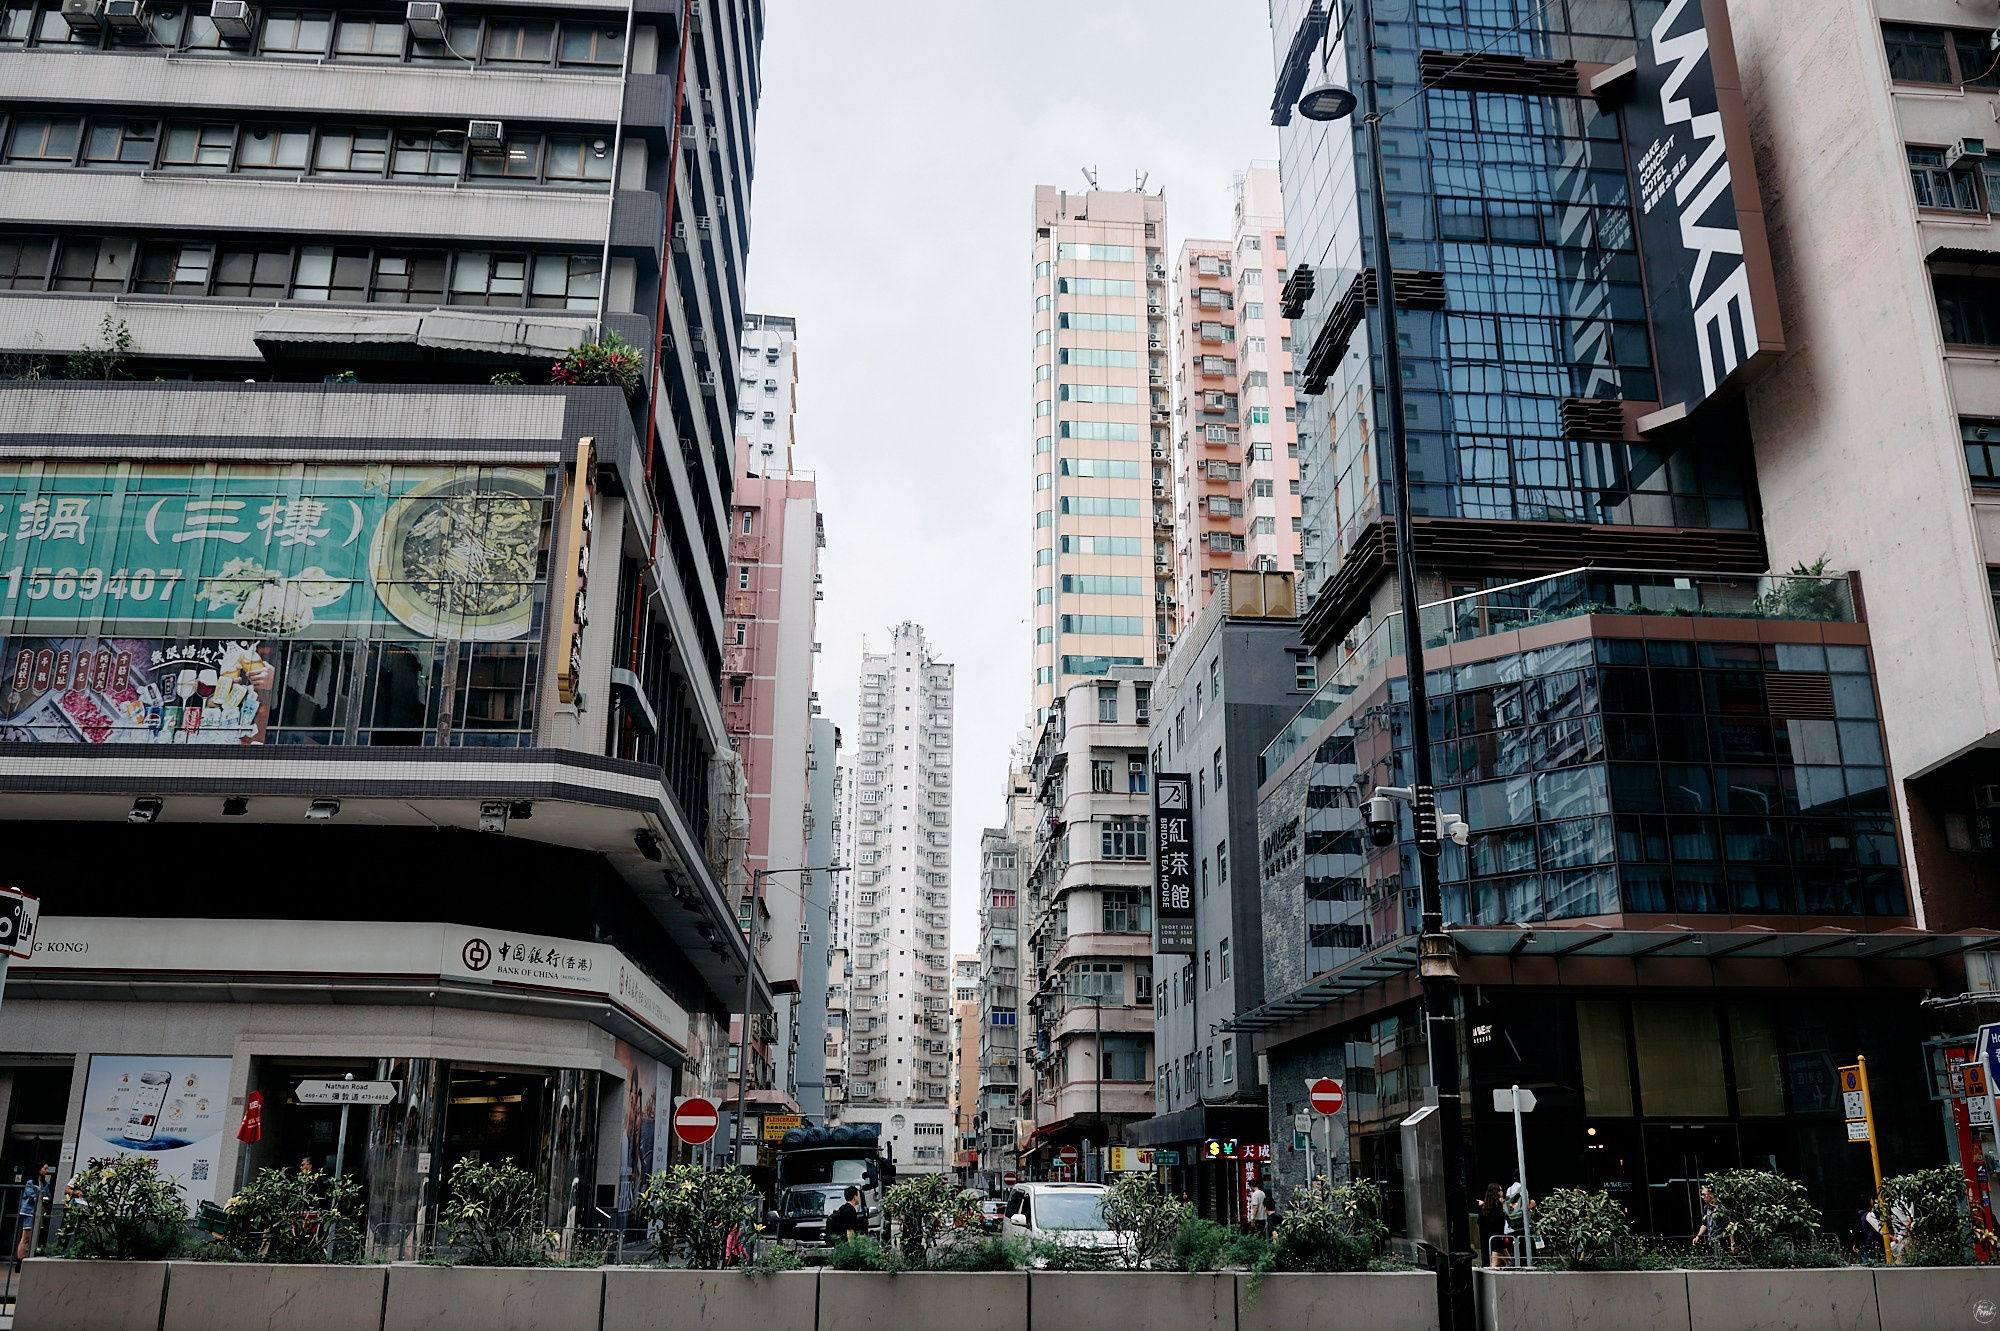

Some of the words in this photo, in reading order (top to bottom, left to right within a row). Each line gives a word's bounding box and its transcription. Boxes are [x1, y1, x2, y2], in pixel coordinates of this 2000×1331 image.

[1637, 138, 1661, 172] WAKE
[1640, 134, 1675, 186] CONCEPT
[1641, 164, 1667, 200] HOTEL
[1651, 0, 1759, 398] WAKE
[1160, 817, 1168, 852] BRIDAL
[1161, 854, 1169, 872] TEA
[1169, 817, 1190, 909] 紅茶館
[1161, 876, 1170, 908] HOUSE
[47, 942, 90, 954] KONG)
[497, 965, 519, 975] BANK
[533, 970, 559, 980] CHINA
[331, 1092, 359, 1101] 彌敦道
[351, 1083, 368, 1091] Road
[1980, 1096, 1985, 1106] 7
[1983, 1110, 1991, 1120] 12
